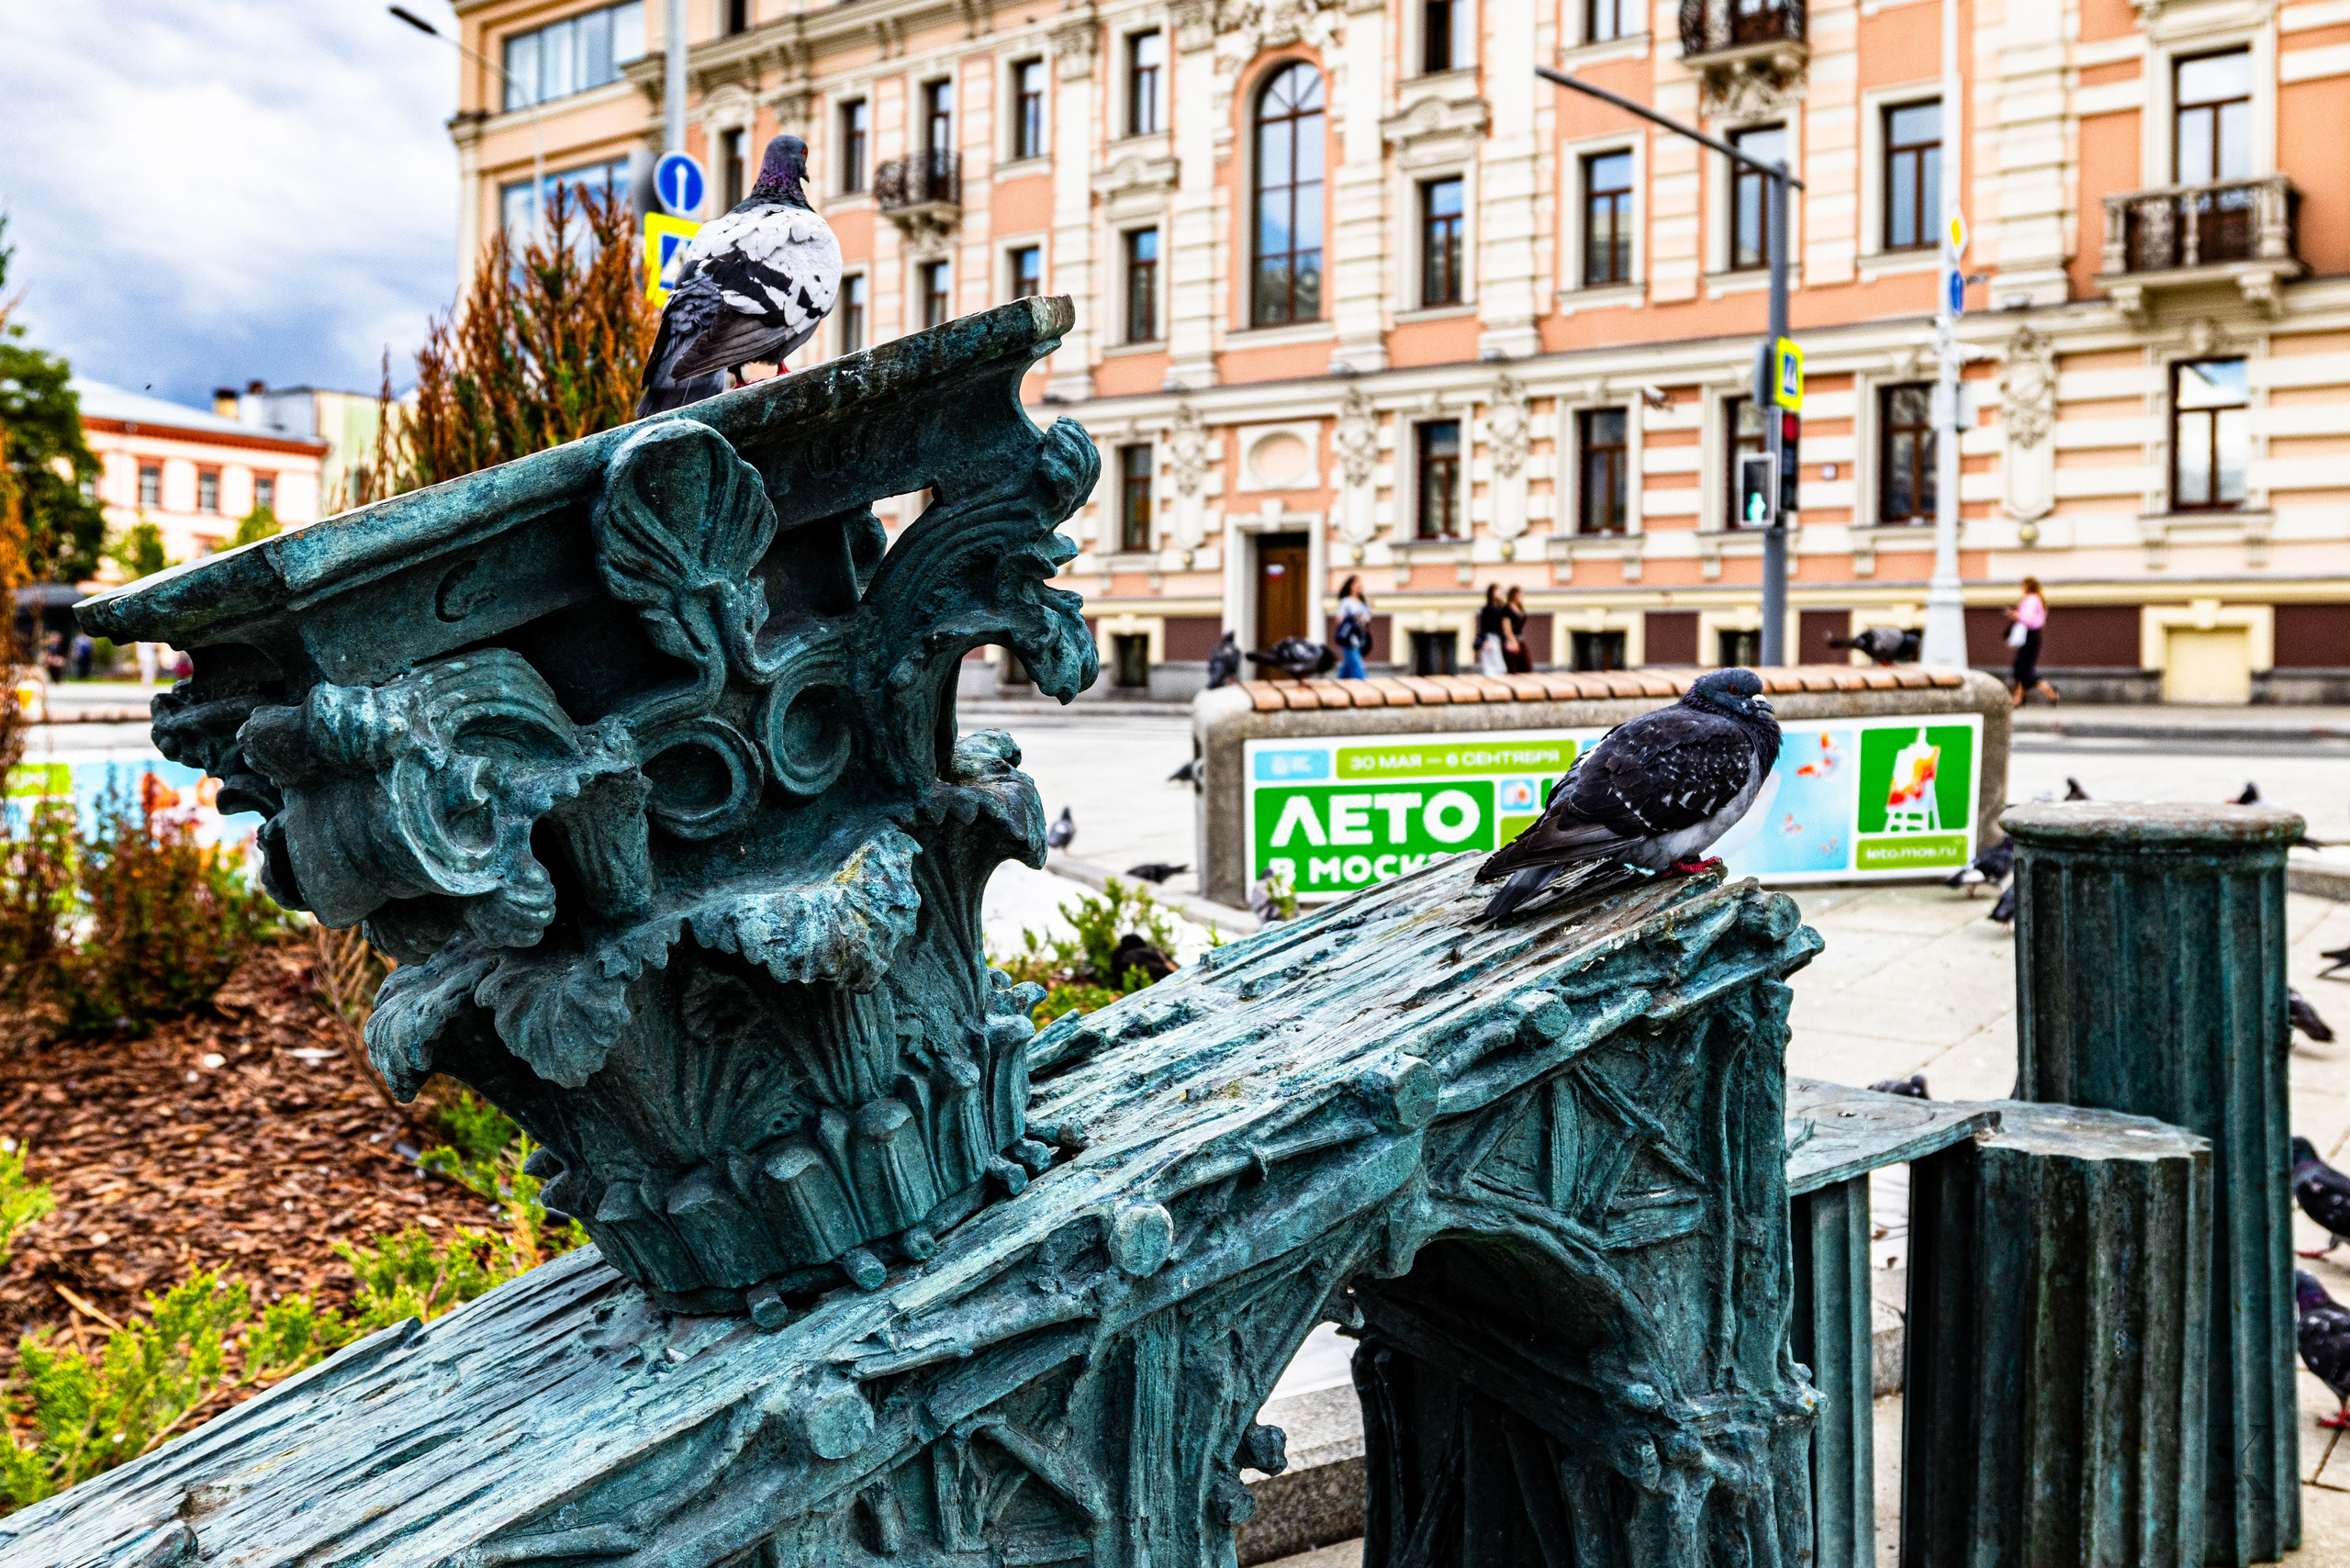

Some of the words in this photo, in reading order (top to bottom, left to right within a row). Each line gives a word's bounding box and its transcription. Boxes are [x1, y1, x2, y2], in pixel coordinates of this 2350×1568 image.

[1350, 756, 1375, 770] 30
[1379, 754, 1421, 768] МАЯ
[1446, 752, 1459, 767] 6
[1461, 749, 1559, 766] СЕНТЯБРЯ
[1270, 790, 1481, 846] ЛЕТО
[1309, 854, 1427, 884] МОСК
